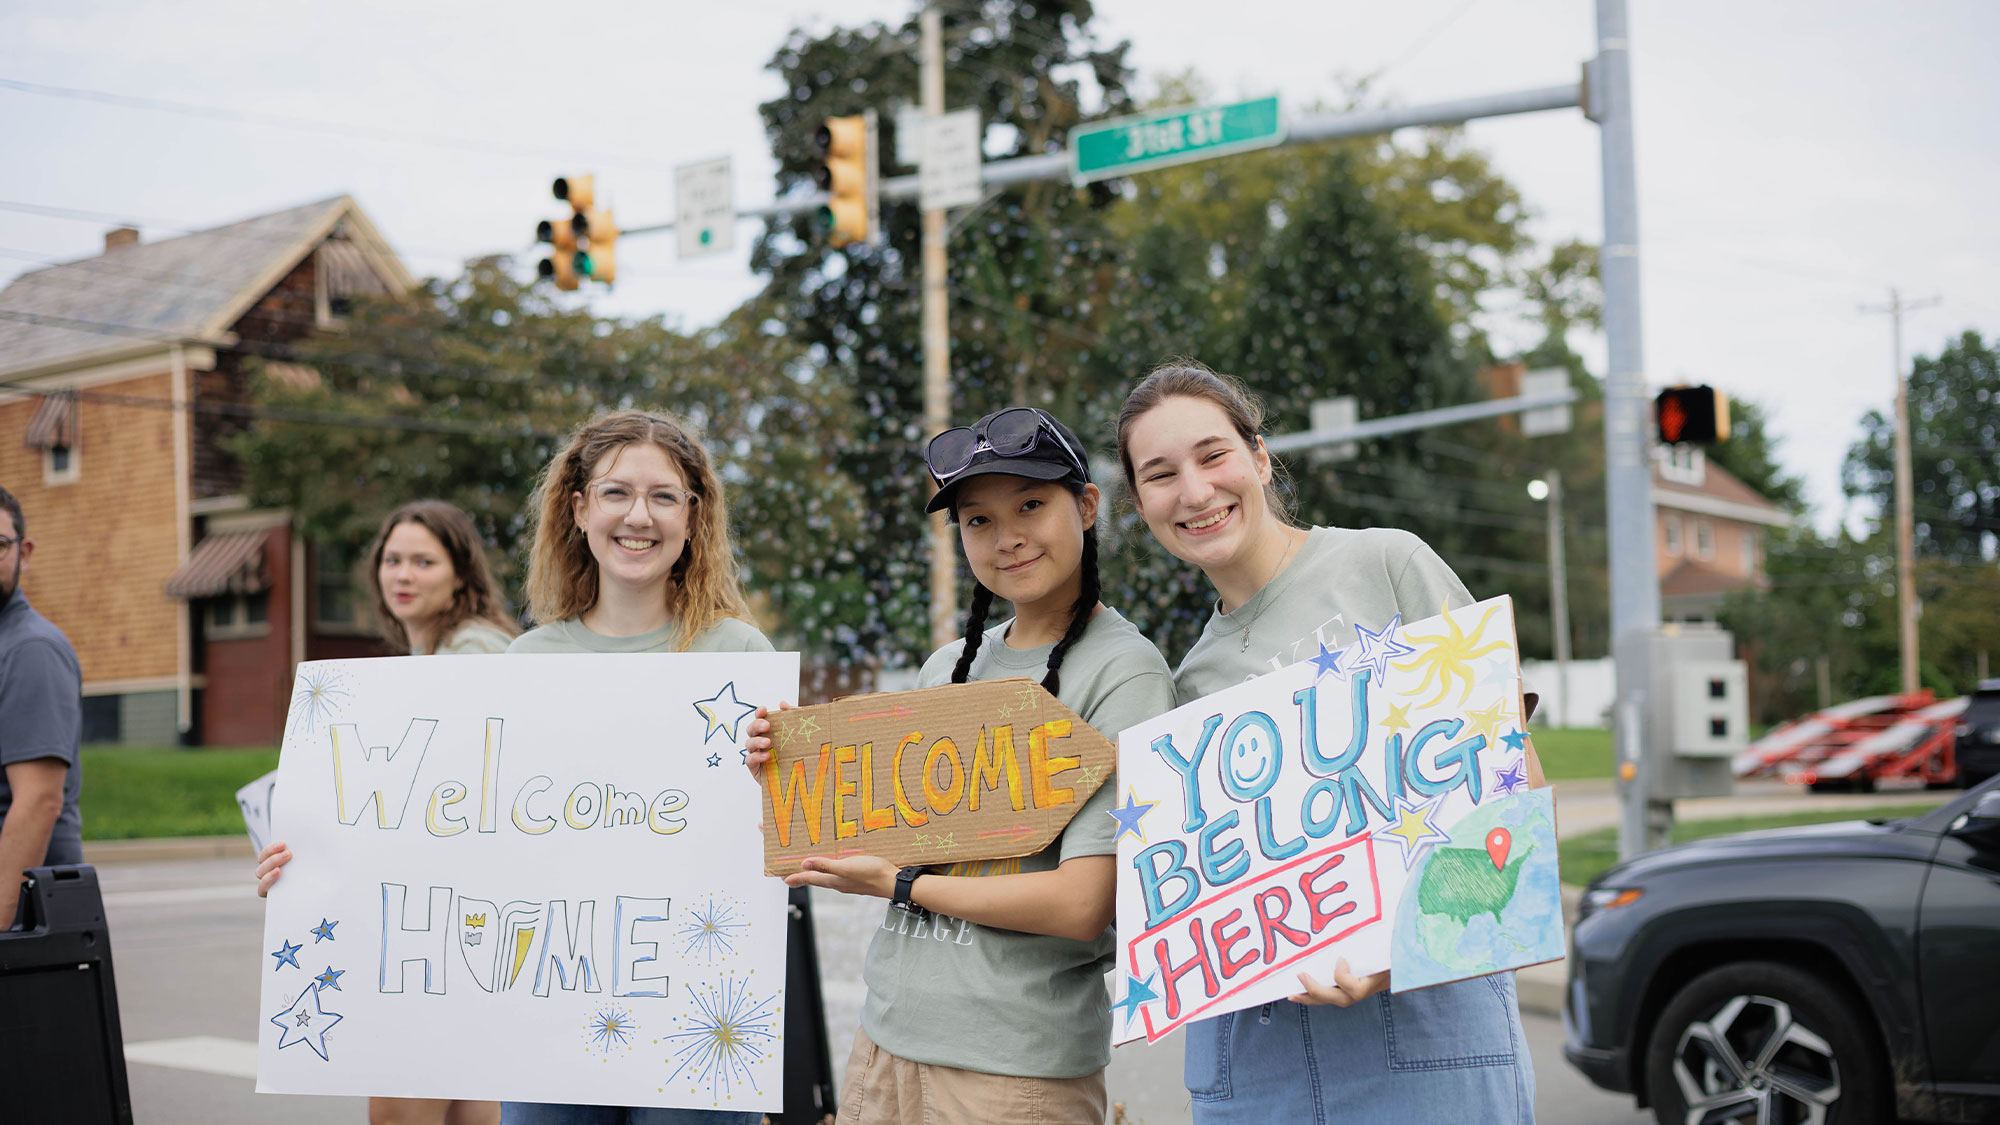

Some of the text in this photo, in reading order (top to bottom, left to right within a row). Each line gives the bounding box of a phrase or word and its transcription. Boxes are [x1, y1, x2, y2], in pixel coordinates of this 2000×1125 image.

[329, 717, 690, 837] Welcome
[762, 719, 1081, 848] WELCOME
[1133, 717, 1487, 931] BELONG
[1150, 668, 1371, 834] YOU
[1153, 853, 1358, 1021] HERE
